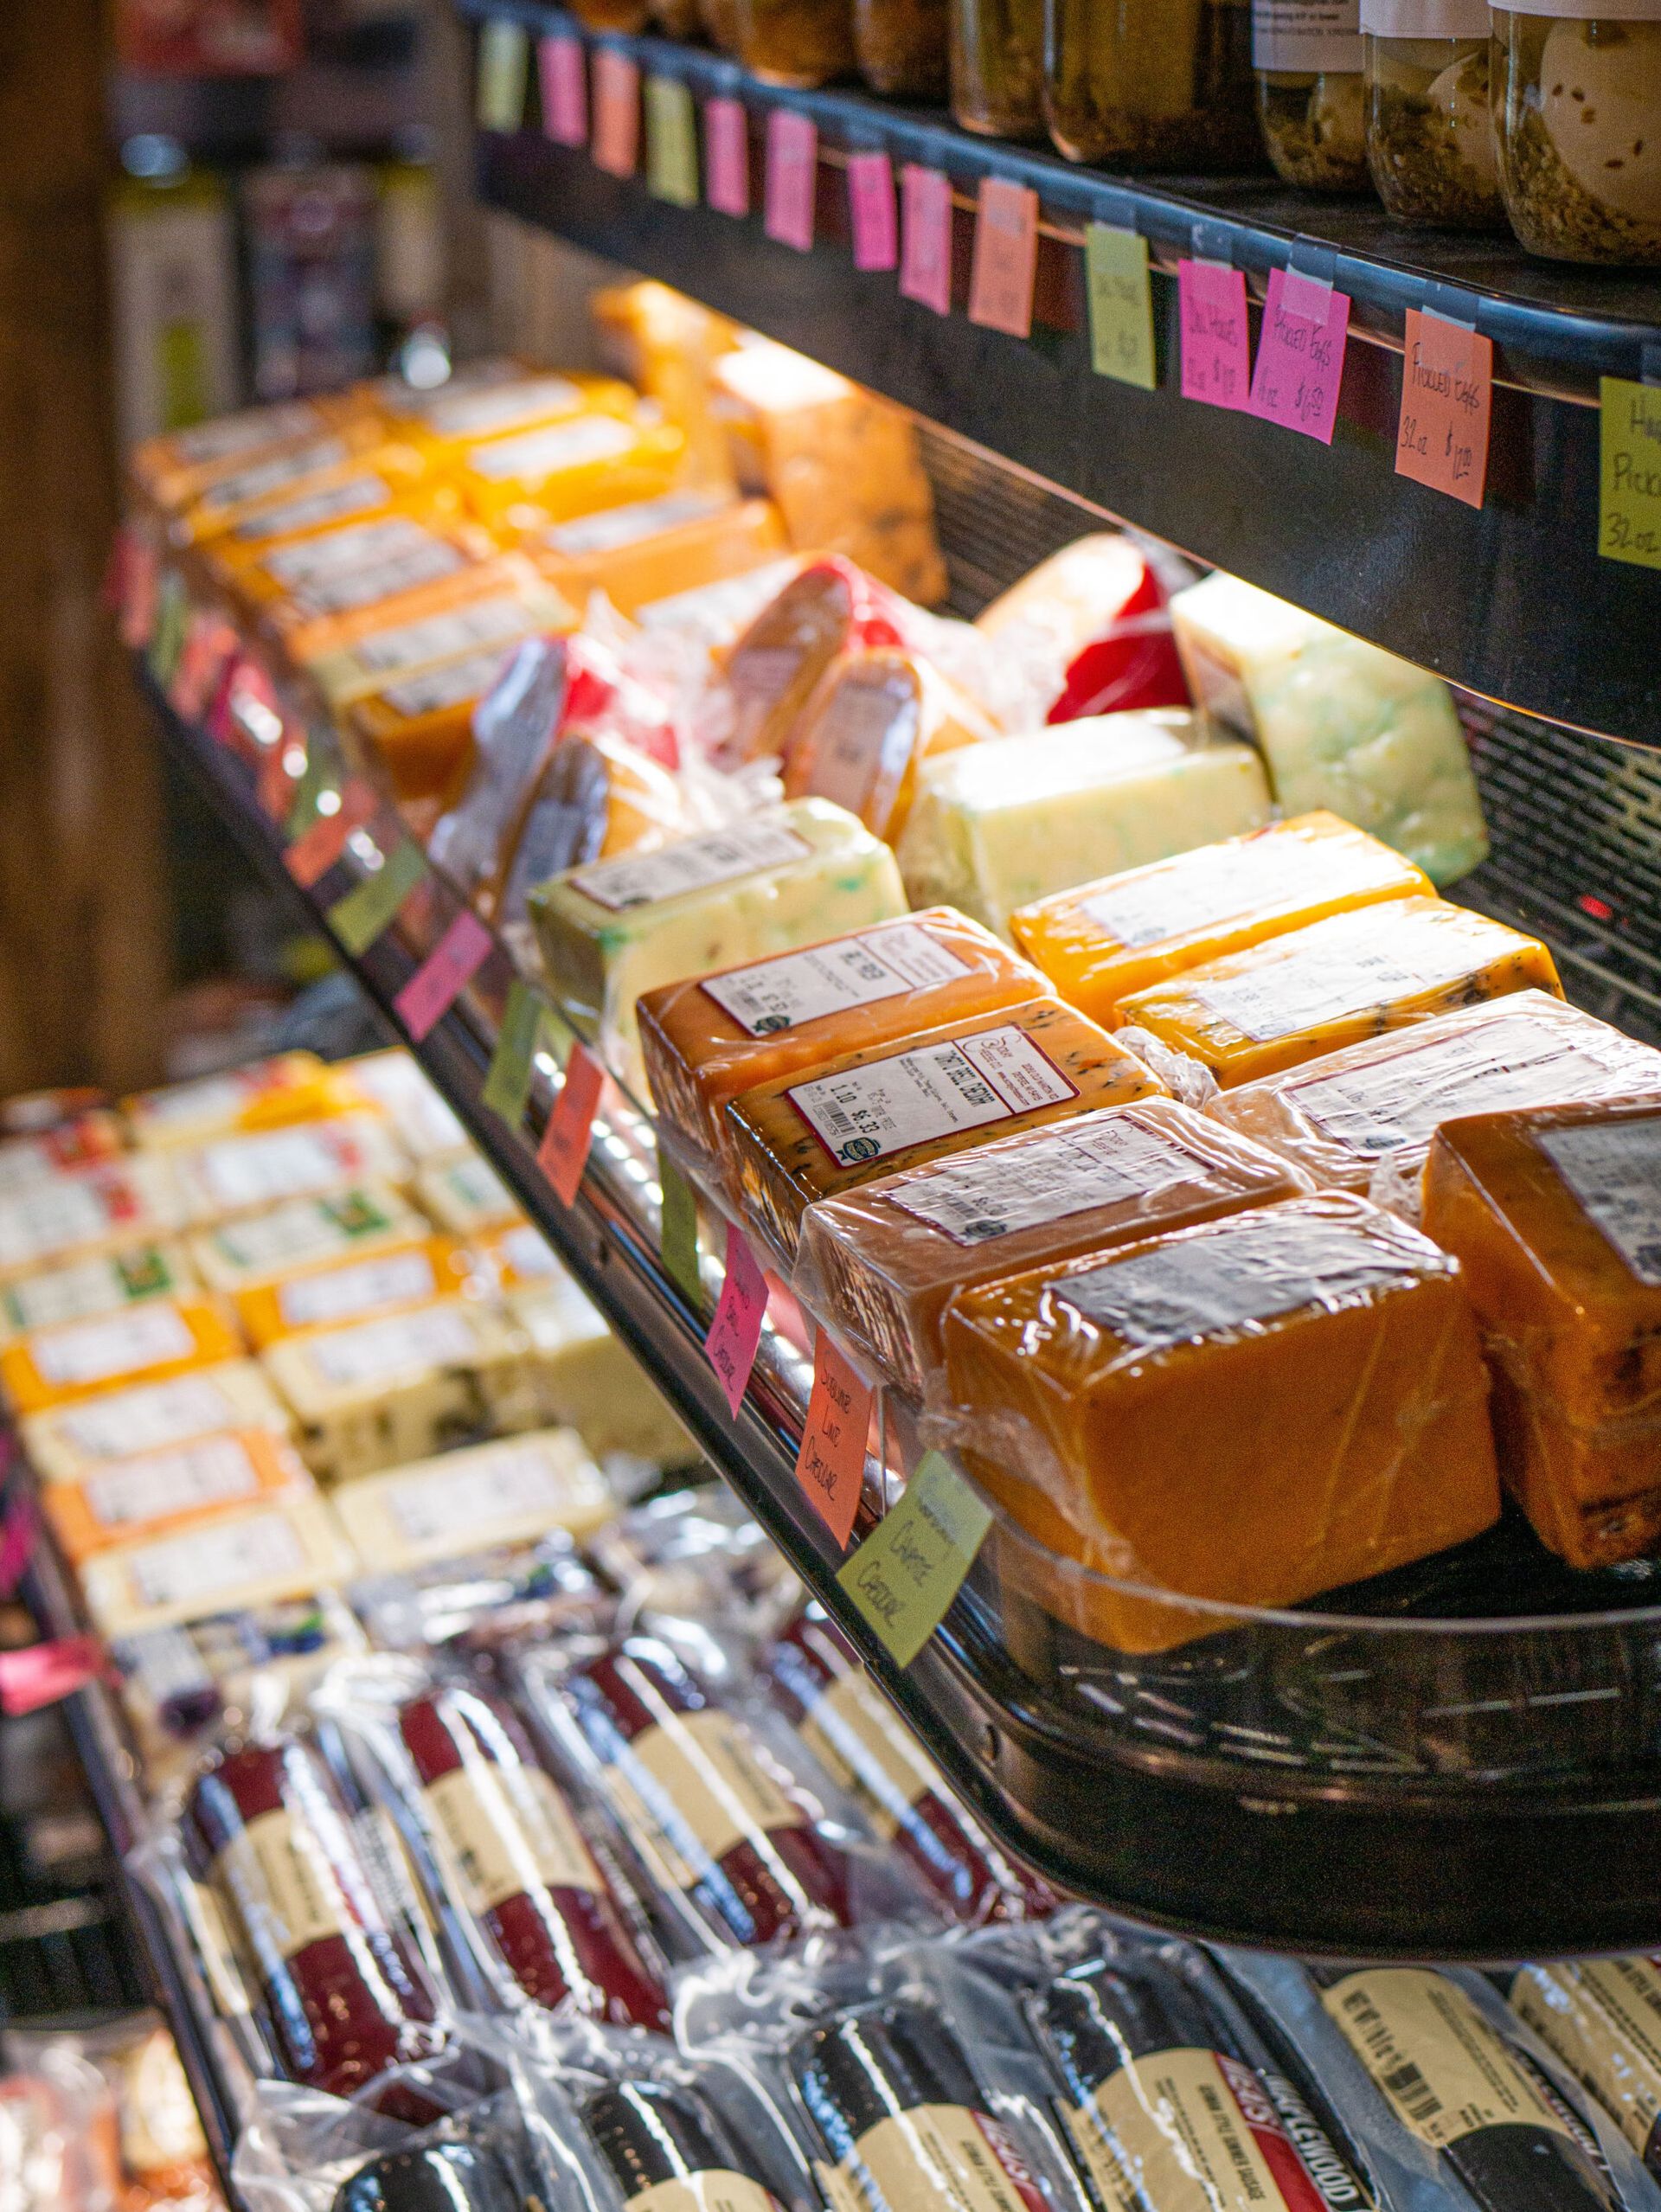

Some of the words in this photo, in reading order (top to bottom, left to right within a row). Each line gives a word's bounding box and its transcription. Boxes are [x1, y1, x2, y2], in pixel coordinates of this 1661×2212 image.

[829, 1083, 858, 1104] 1.10
[848, 1108, 881, 1134] $6.33
[805, 1435, 837, 1502] CHEDDAR
